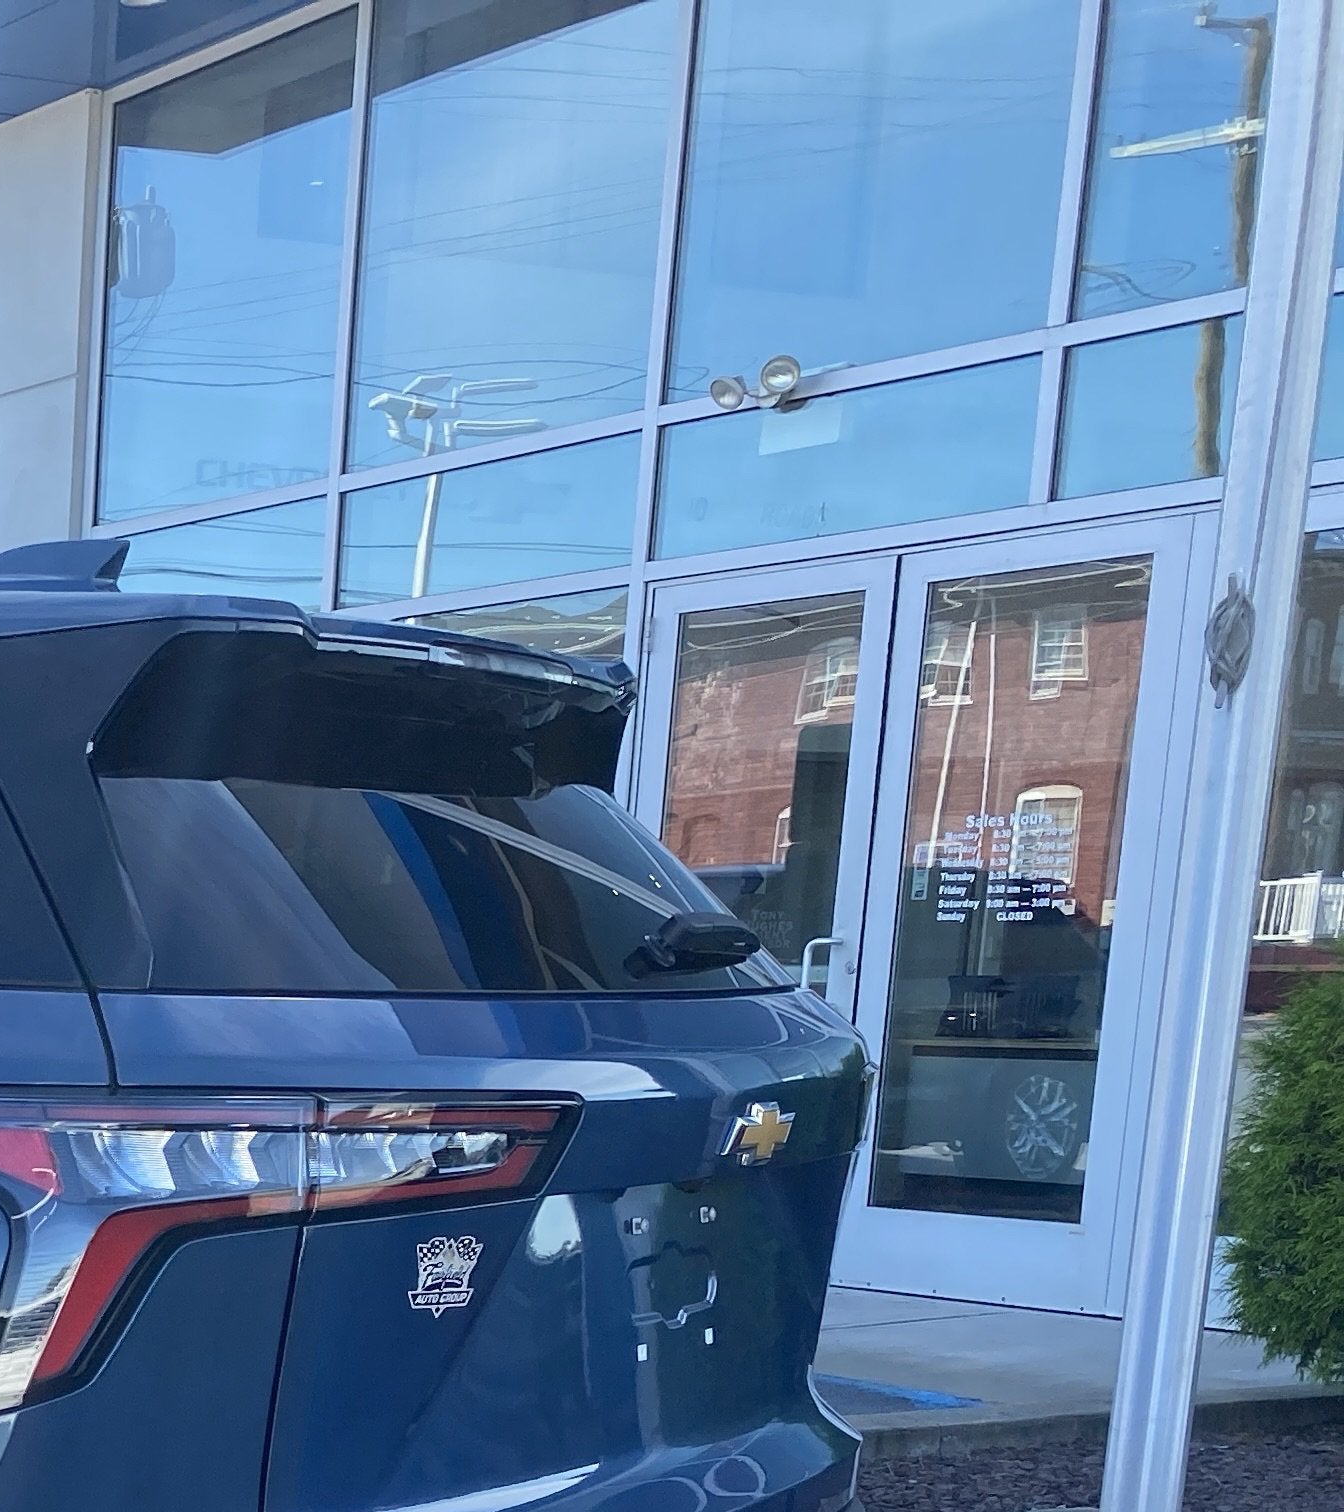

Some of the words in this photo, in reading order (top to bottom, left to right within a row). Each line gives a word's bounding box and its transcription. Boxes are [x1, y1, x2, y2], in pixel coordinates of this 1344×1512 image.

[966, 814, 1005, 828] Sales
[1010, 812, 1053, 826] Hours
[945, 832, 979, 841] Monday
[940, 872, 976, 882] Thursday
[938, 885, 967, 896] Friday
[938, 899, 980, 910] Saturday
[937, 912, 966, 923] Sunday
[996, 912, 1033, 921] CLOSED
[414, 1294, 439, 1304] AUTO
[439, 1293, 468, 1303] GROUP
